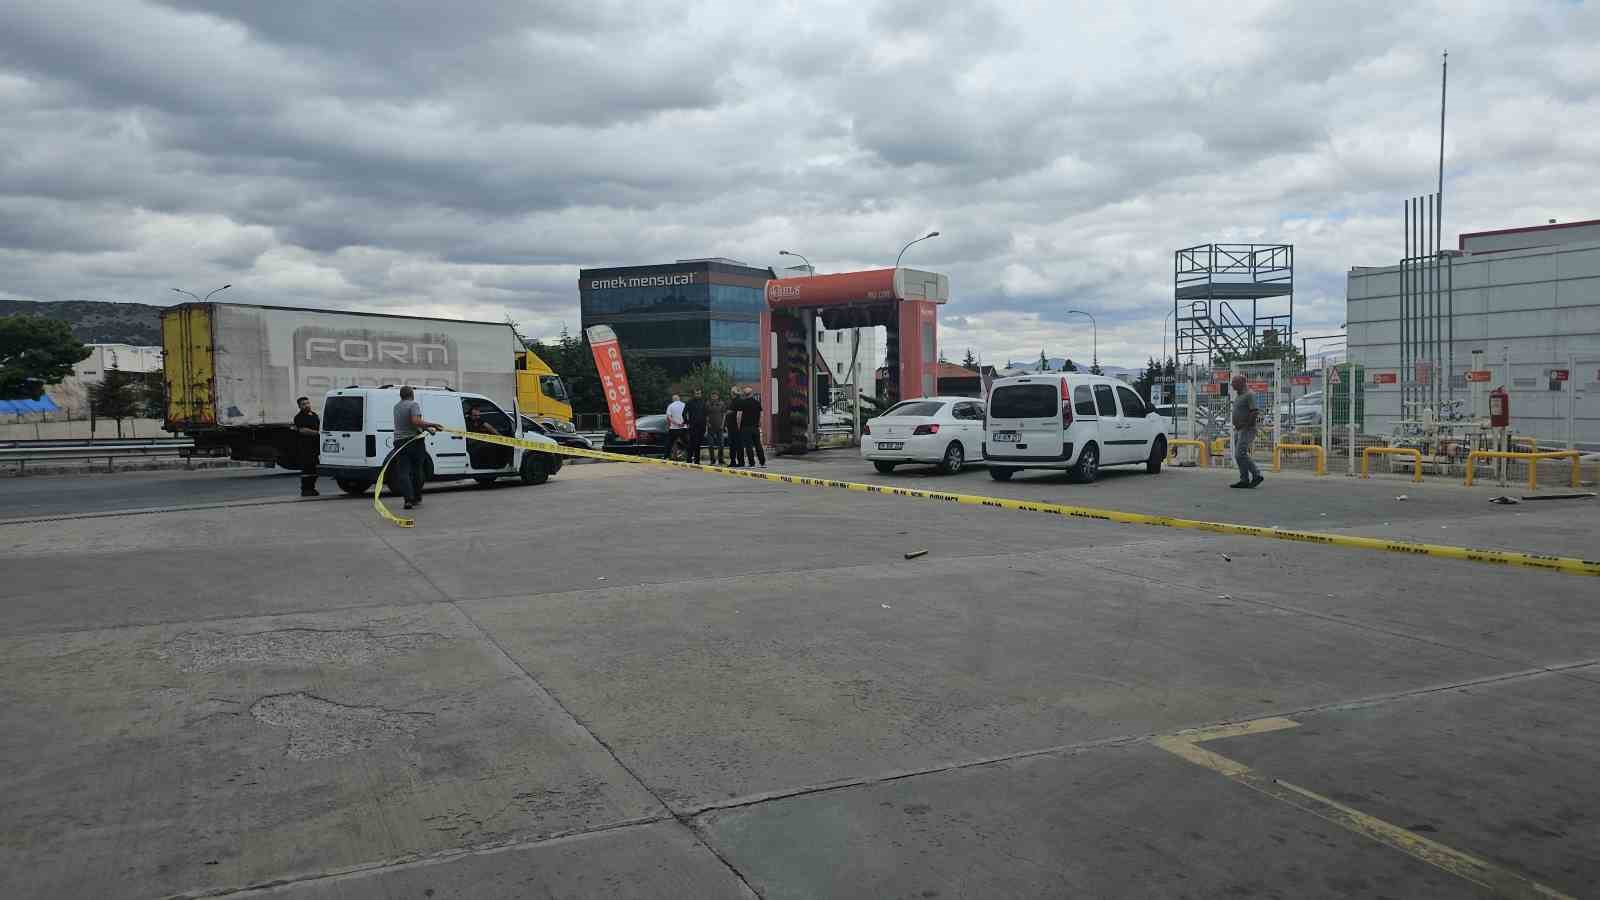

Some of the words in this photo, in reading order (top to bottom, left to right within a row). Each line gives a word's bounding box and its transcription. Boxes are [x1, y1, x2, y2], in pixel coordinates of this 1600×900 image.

[591, 275, 627, 290] emek
[629, 271, 698, 288] mensucat
[304, 337, 449, 365] FORM
